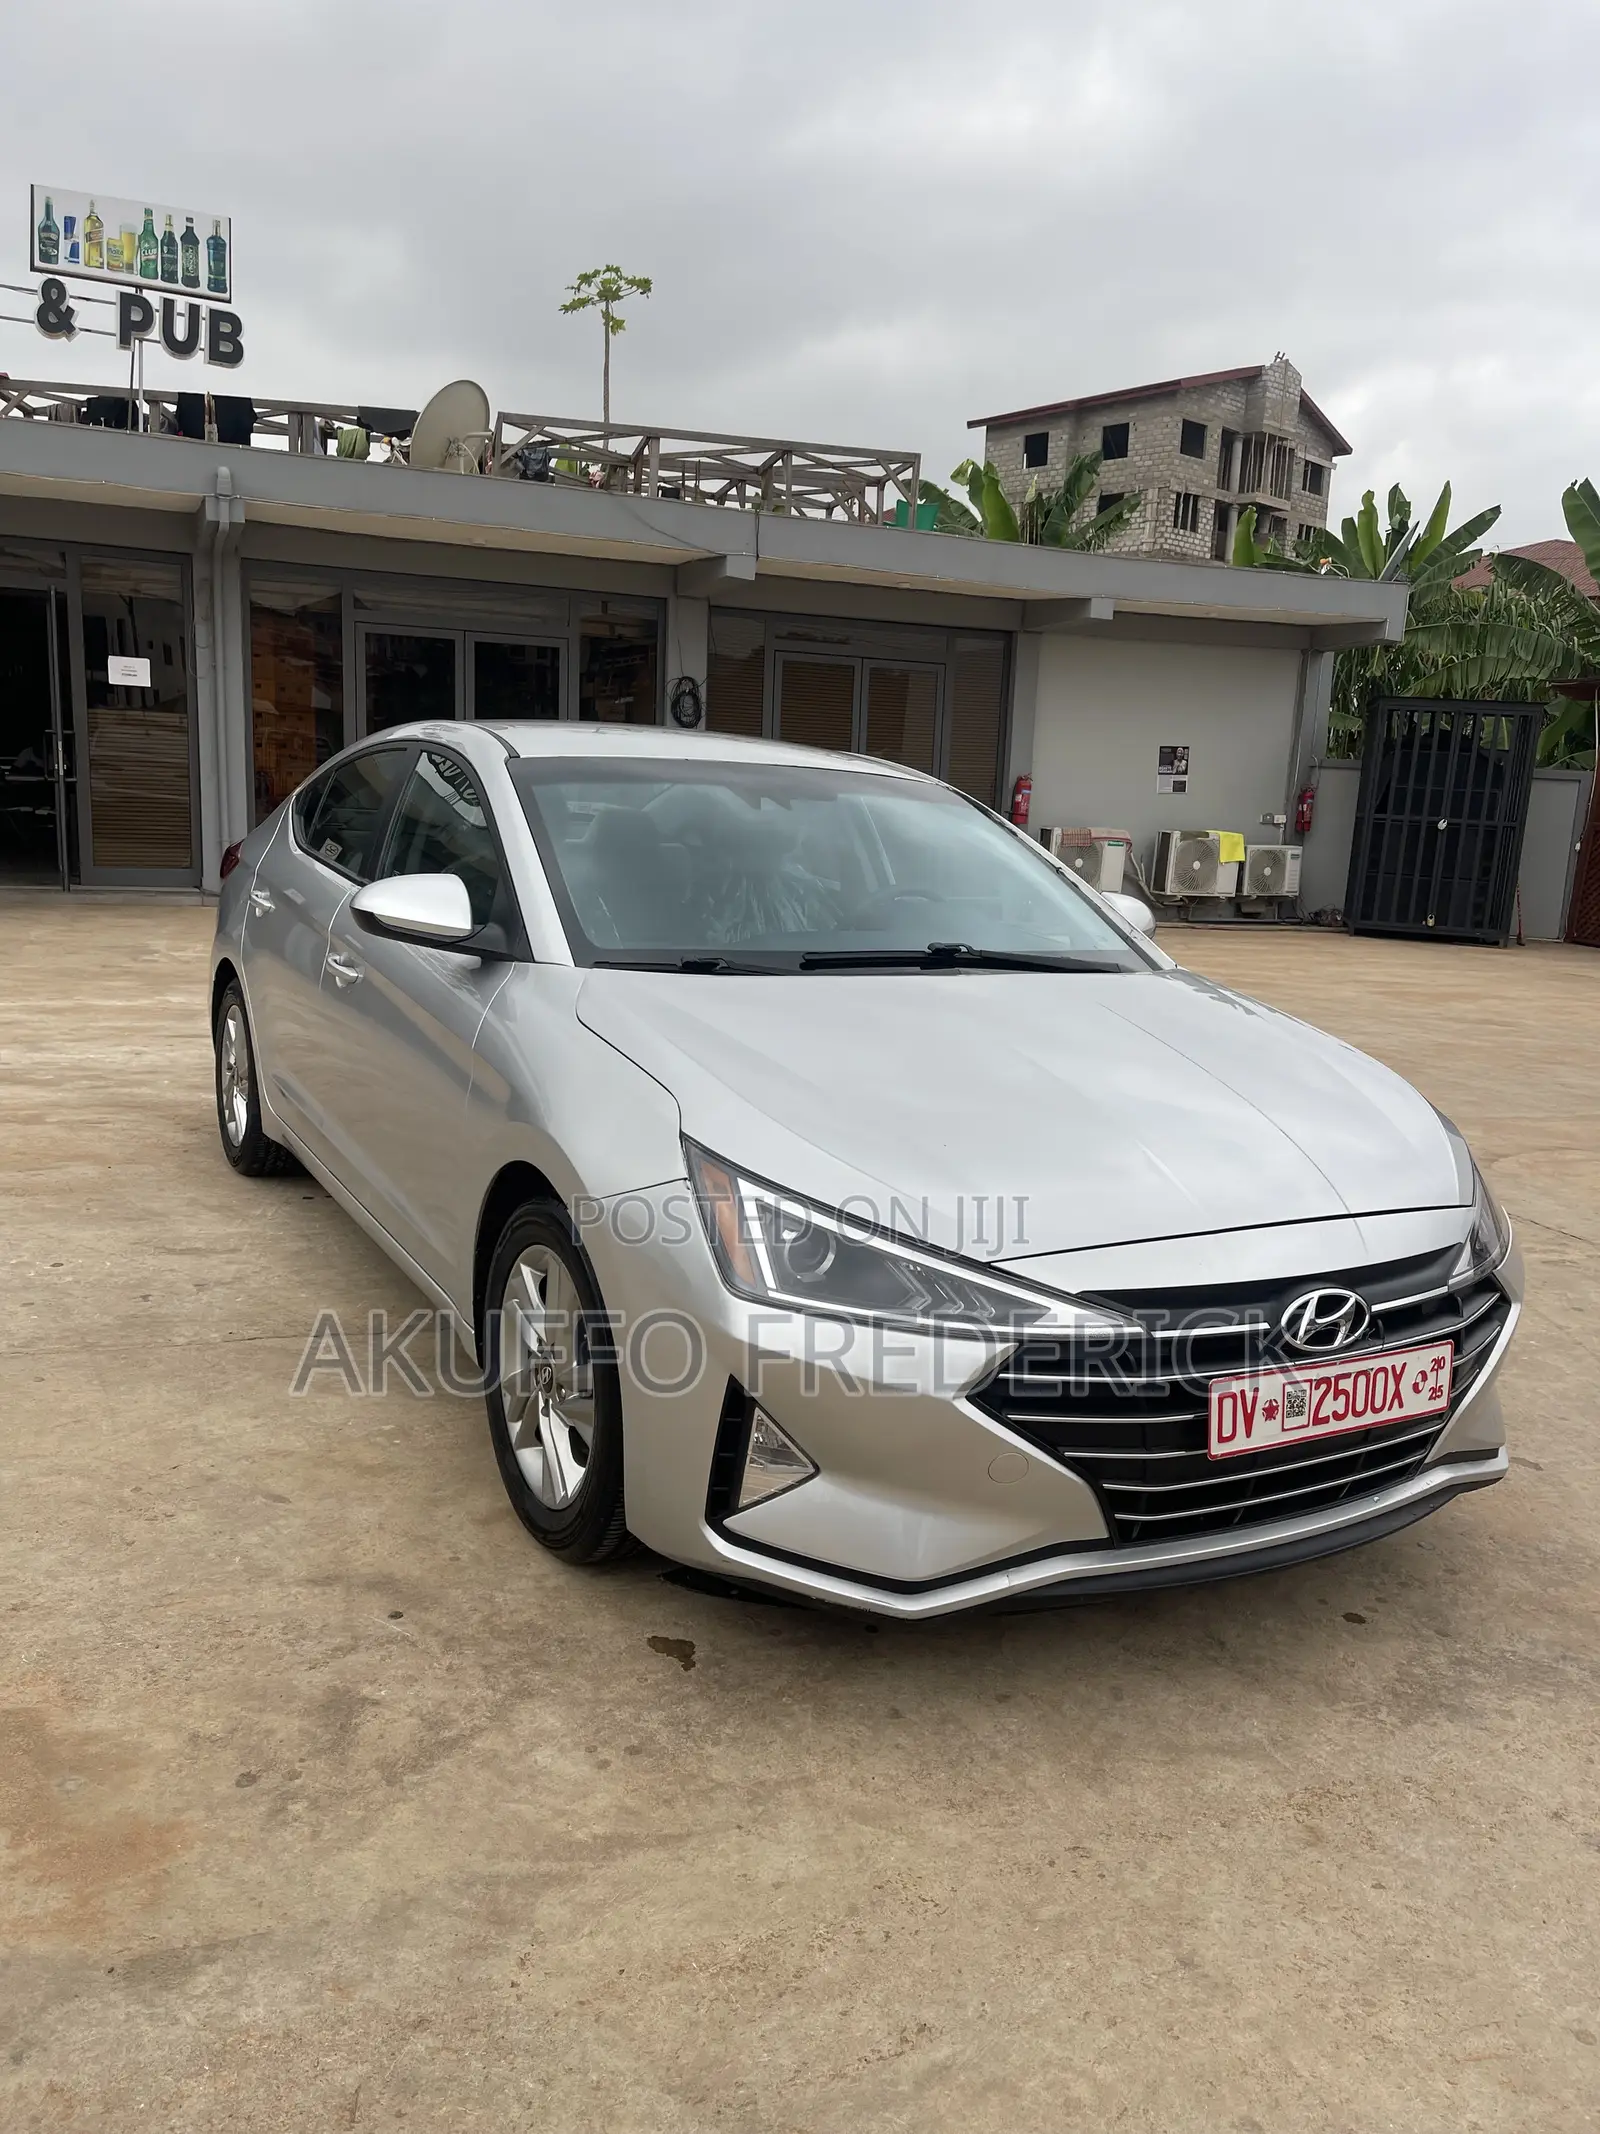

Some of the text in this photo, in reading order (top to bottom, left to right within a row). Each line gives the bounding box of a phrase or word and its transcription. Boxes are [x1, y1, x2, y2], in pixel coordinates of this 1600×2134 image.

[35, 278, 244, 369] & PUB
[1217, 1362, 1408, 1443] DV 2500X
